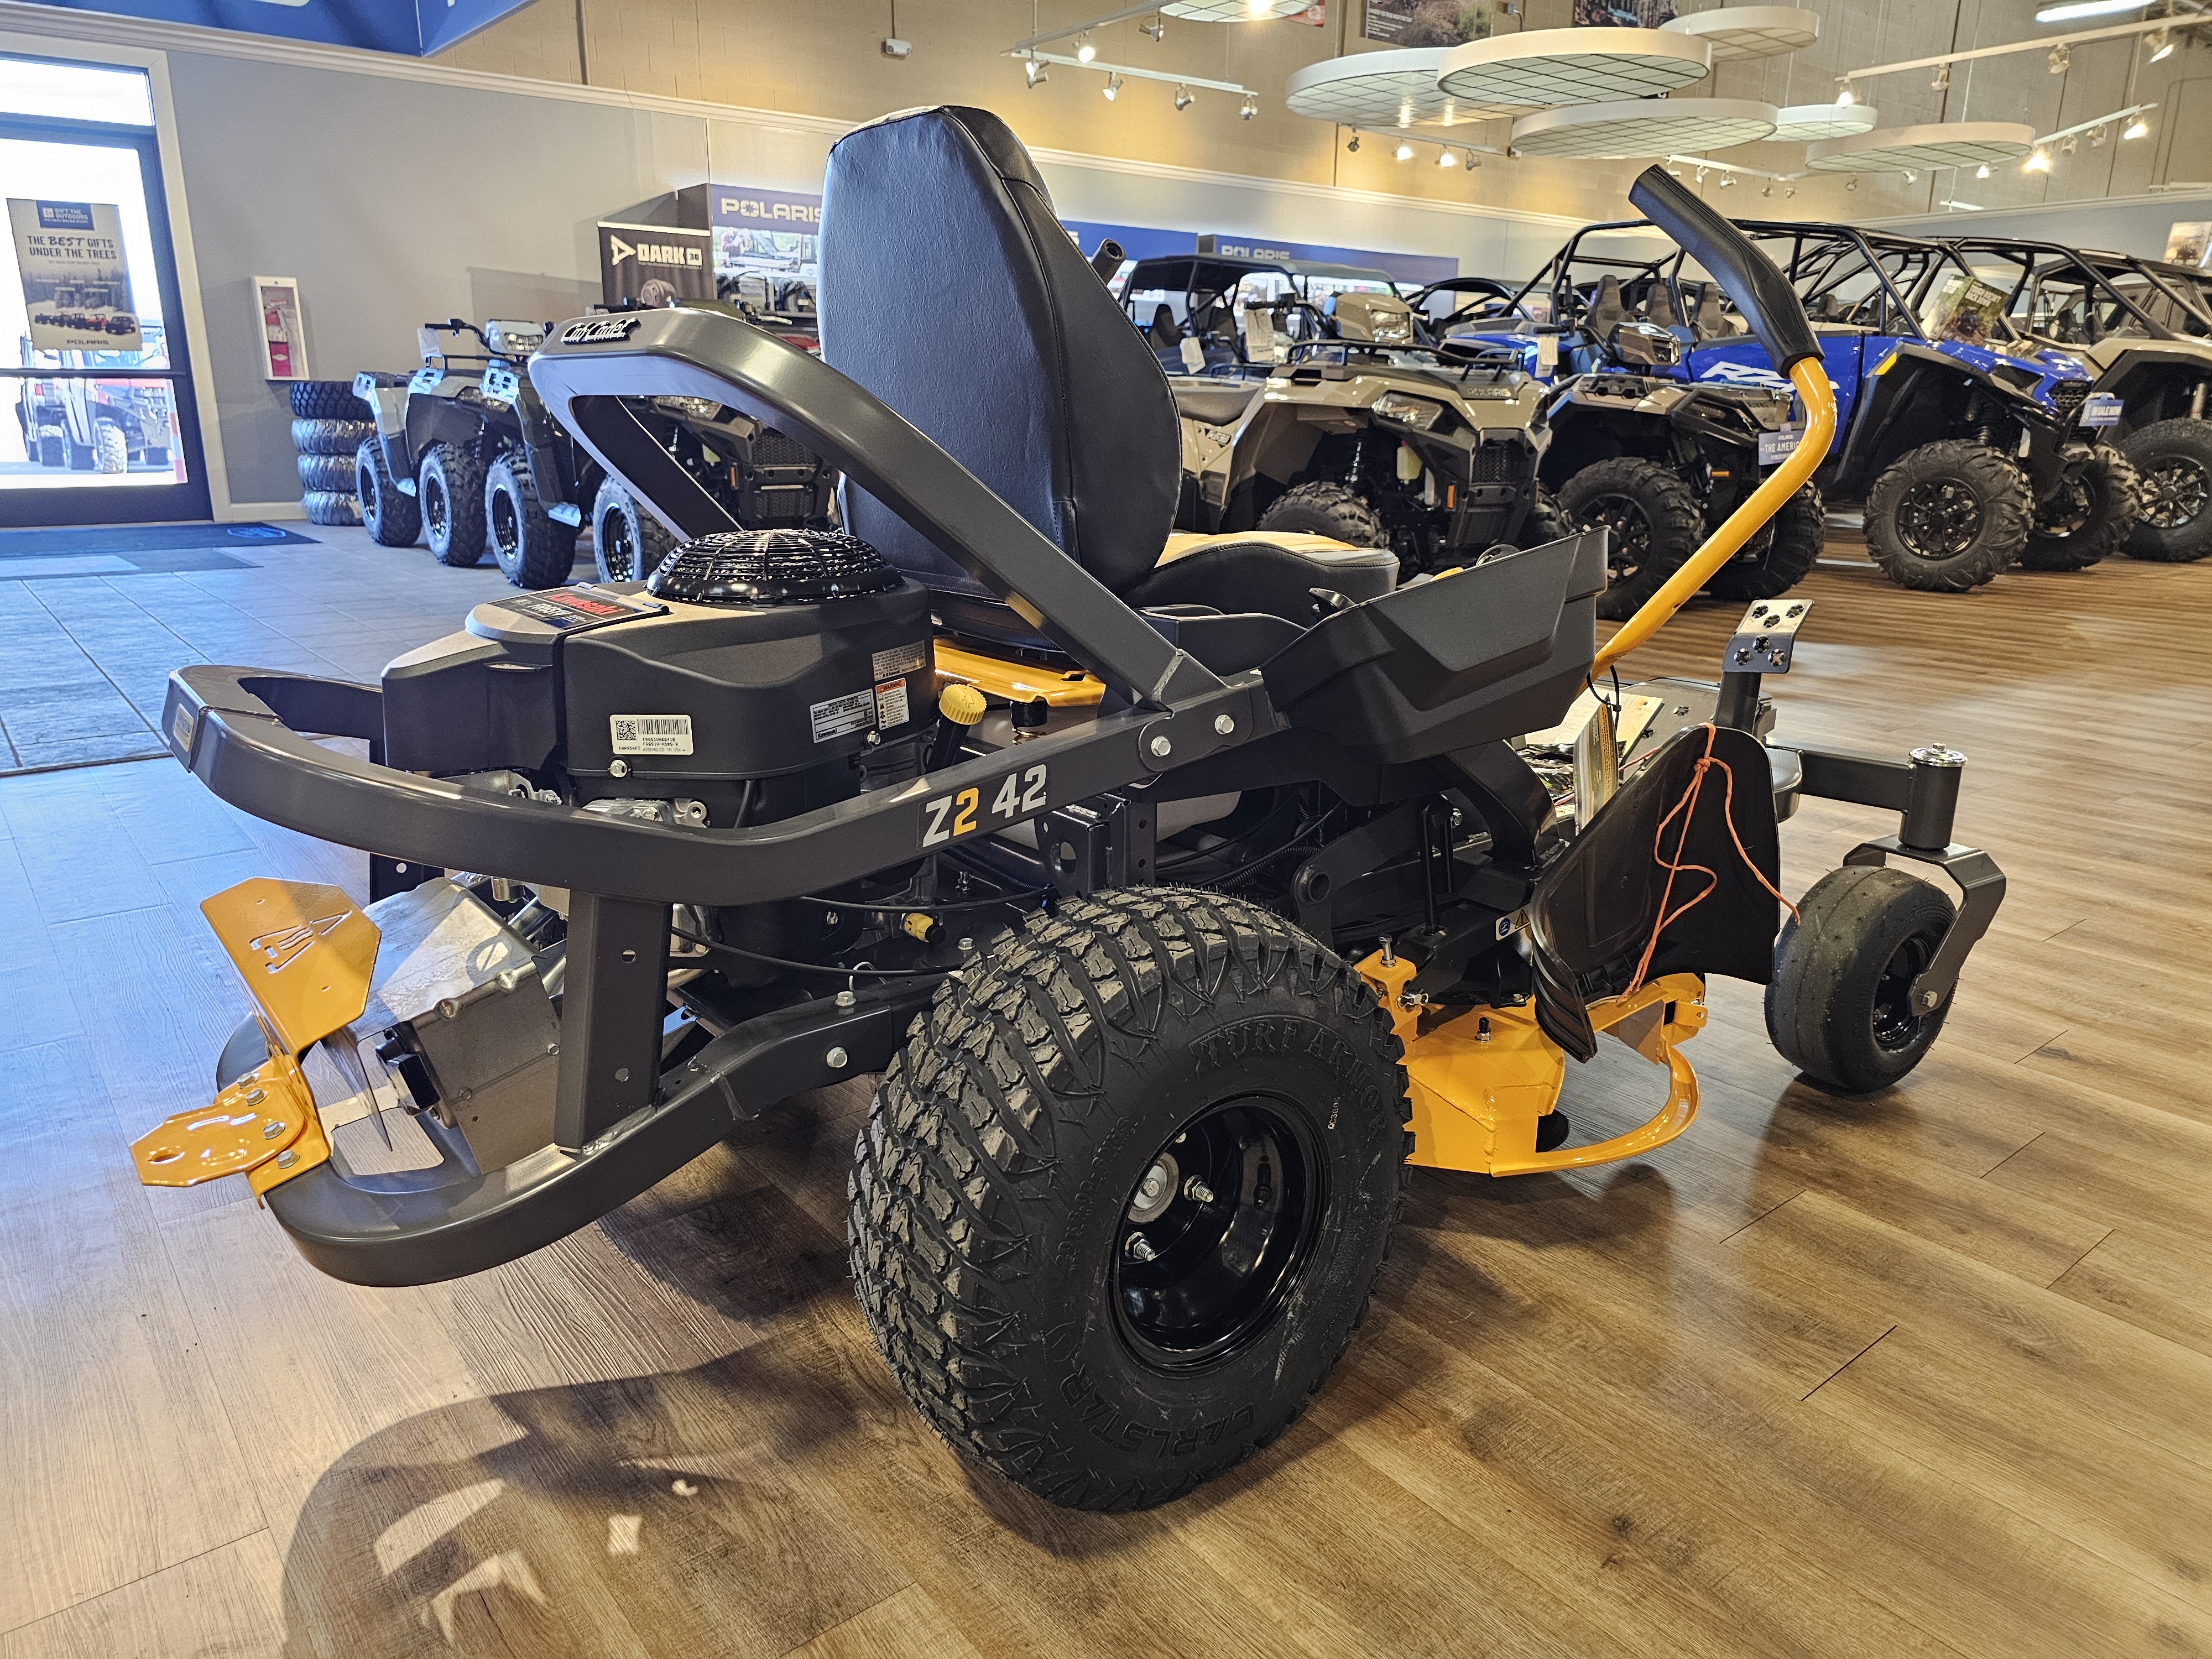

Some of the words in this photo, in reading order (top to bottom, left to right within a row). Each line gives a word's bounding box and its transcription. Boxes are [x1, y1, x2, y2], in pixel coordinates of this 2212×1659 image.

[27, 235, 46, 245] THE
[48, 236, 85, 246] BEST
[87, 238, 113, 248] GIFTS
[29, 247, 61, 257] UNDER
[65, 248, 84, 258] THE
[86, 249, 117, 259] TREES
[637, 243, 686, 264] DARK
[1467, 388, 1511, 397] POLARIS
[1765, 443, 1776, 453] THE
[543, 592, 625, 615] Kawasaki
[883, 680, 902, 690] WARNING
[922, 787, 979, 848] Z2
[992, 764, 1047, 818] 42
[1200, 1019, 1301, 1067] TURF
